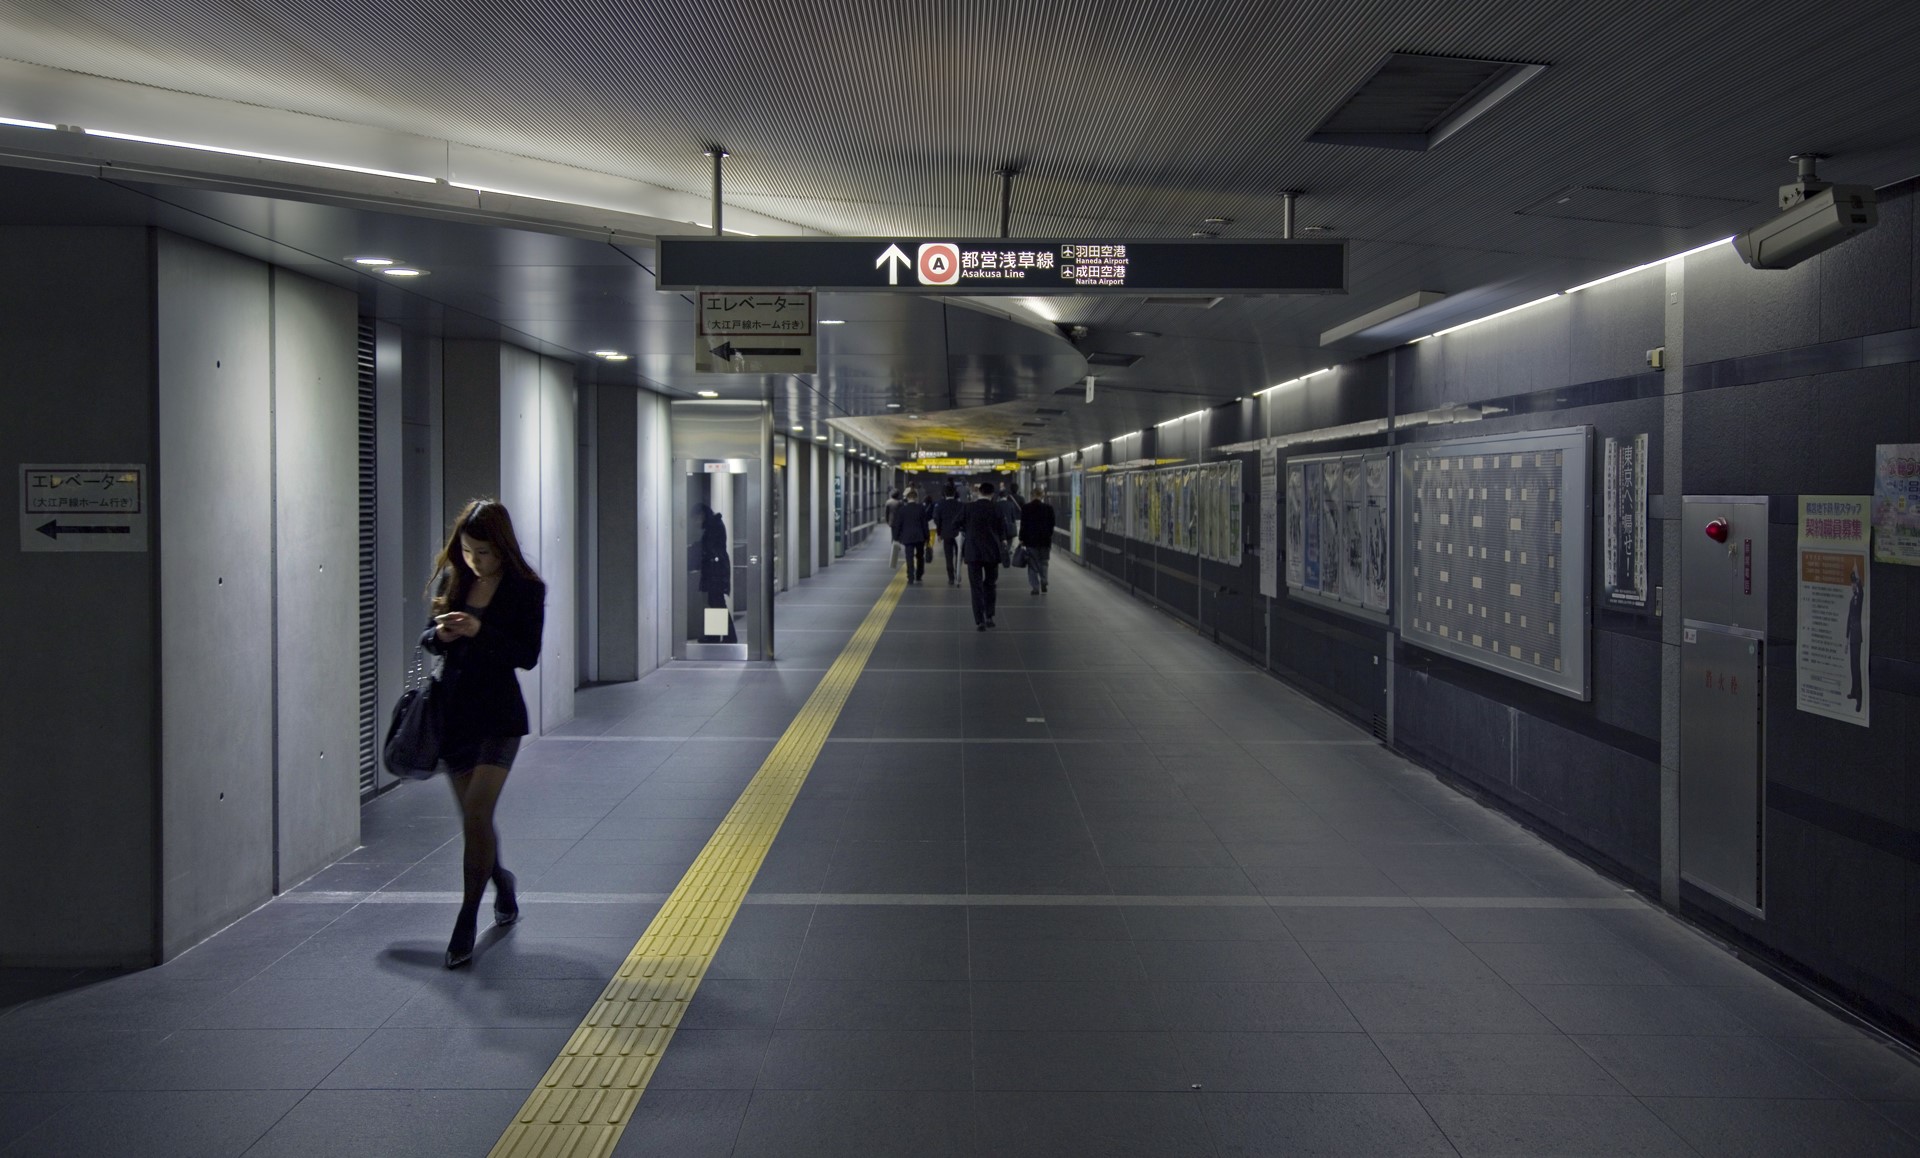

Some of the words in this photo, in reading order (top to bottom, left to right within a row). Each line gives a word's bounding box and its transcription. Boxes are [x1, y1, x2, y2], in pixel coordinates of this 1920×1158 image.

[1075, 244, 1126, 258] 羽田空港
[933, 257, 945, 271] A
[961, 251, 1054, 269] 都営浅草線
[1103, 258, 1129, 266] Airport
[961, 270, 1001, 278] Asakusa
[1005, 270, 1025, 278] Line
[1075, 265, 1126, 278] 成田空港
[1099, 278, 1124, 286] Airport
[707, 296, 805, 312] エレベーター
[32, 473, 135, 490] エレベーター
[1806, 519, 1862, 539] 契約職員募集
